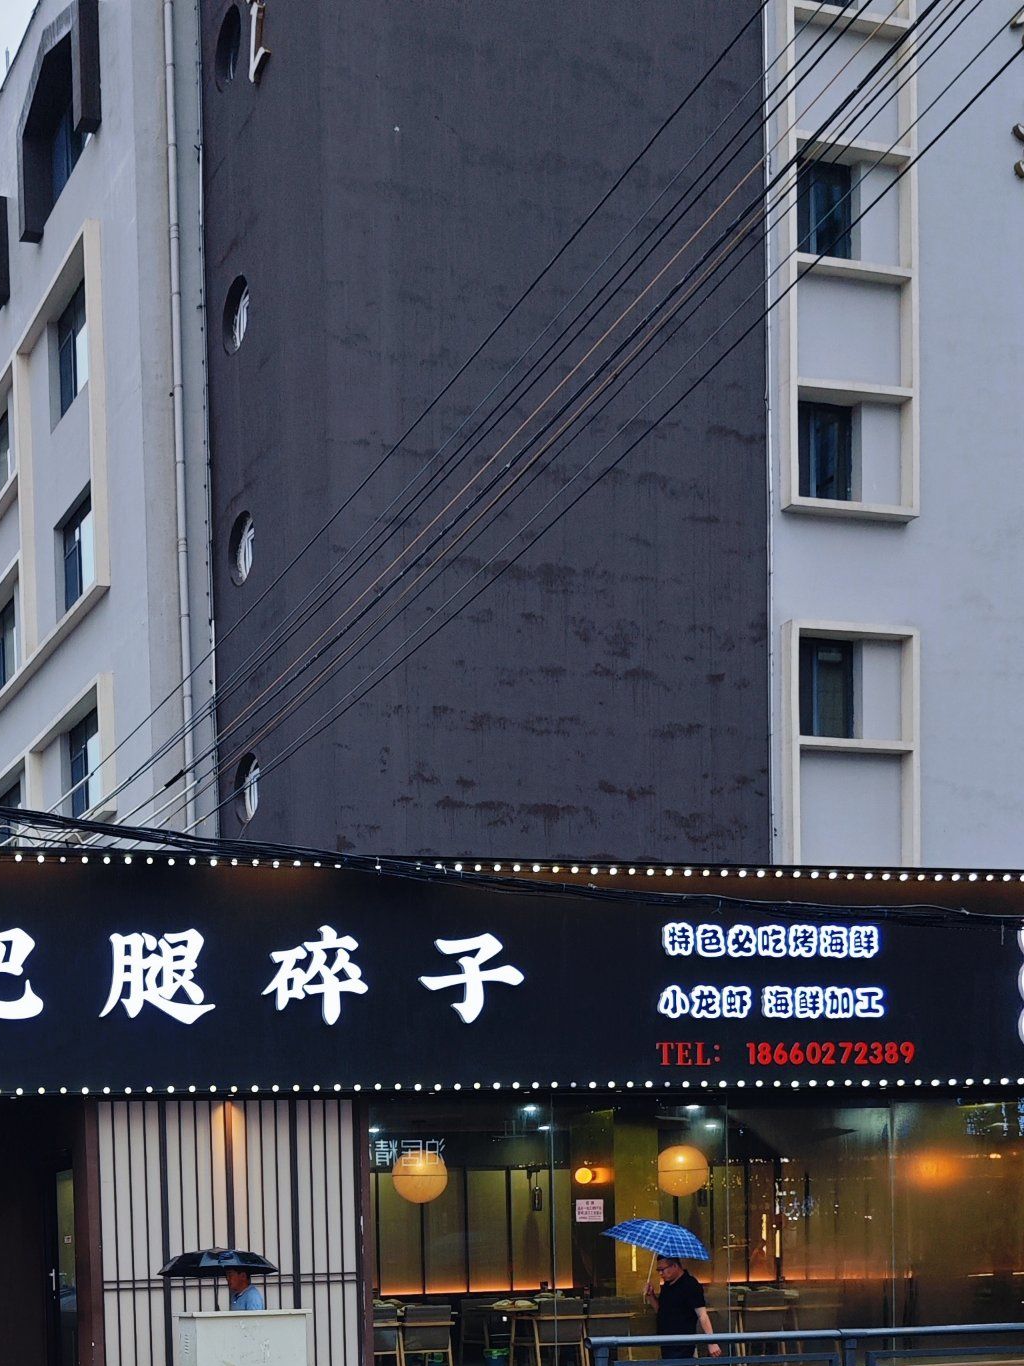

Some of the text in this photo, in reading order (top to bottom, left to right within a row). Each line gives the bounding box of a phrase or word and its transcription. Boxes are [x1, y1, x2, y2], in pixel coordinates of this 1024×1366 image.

[662, 922, 879, 958] 特色必吃烤海鲜
[658, 985, 885, 1019] 小龙虾 海鲜加工
[746, 1041, 915, 1066] 18660272389
